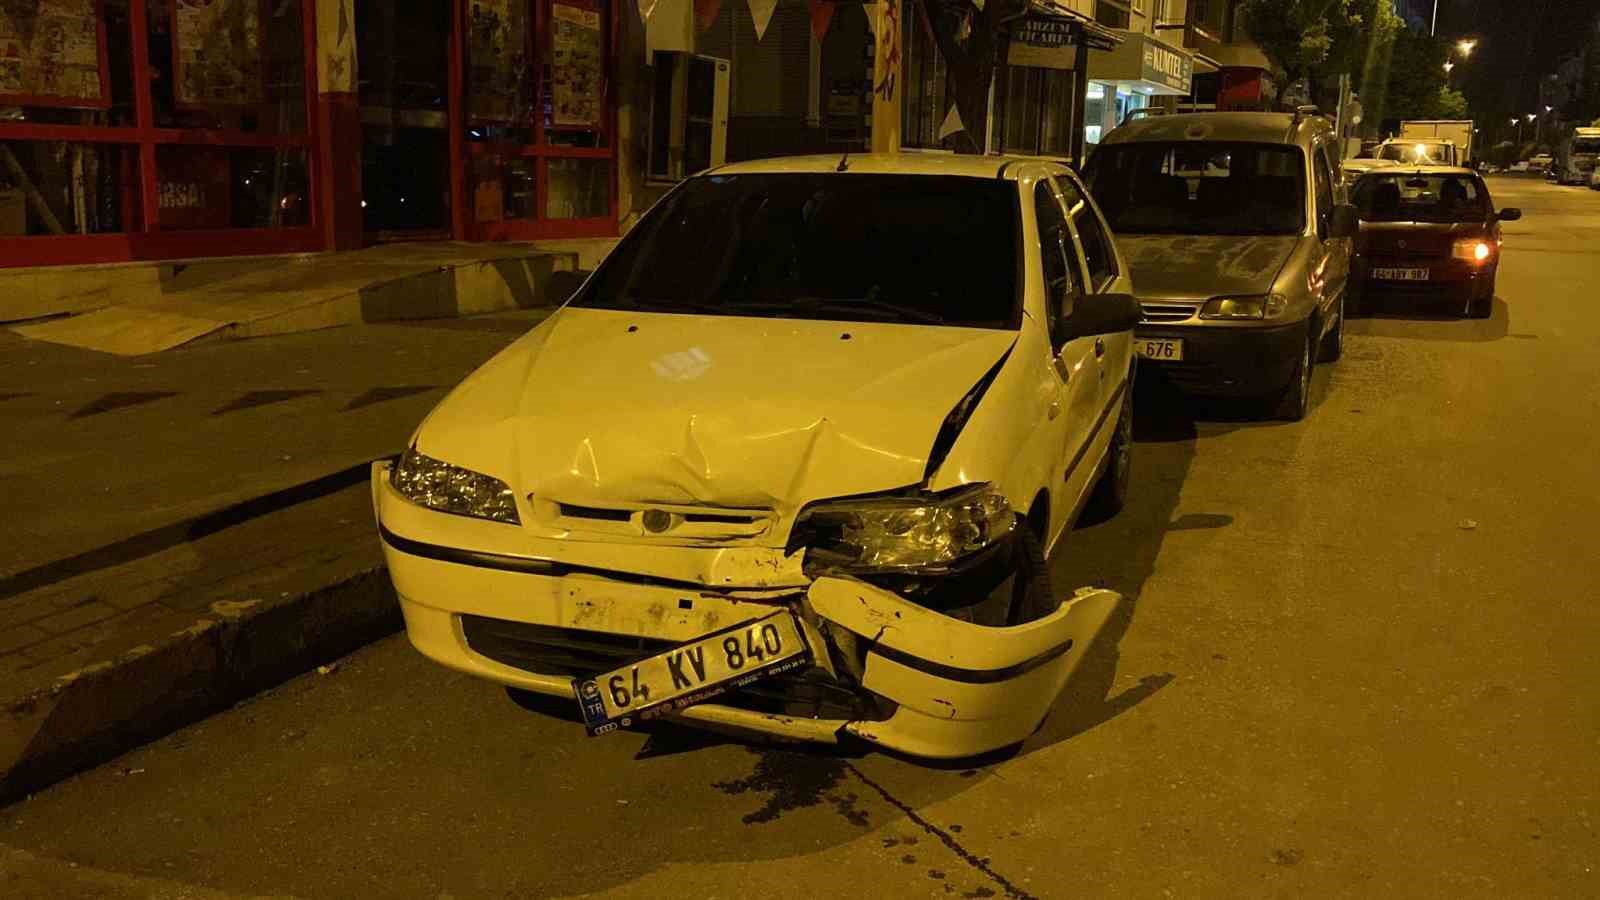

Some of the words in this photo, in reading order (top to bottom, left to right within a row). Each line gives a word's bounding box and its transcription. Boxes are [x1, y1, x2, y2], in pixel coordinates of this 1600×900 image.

[1146, 342, 1174, 358] 676
[607, 666, 649, 708] 64
[666, 645, 706, 691] KV
[722, 623, 782, 669] 840
[586, 702, 604, 716] TR
